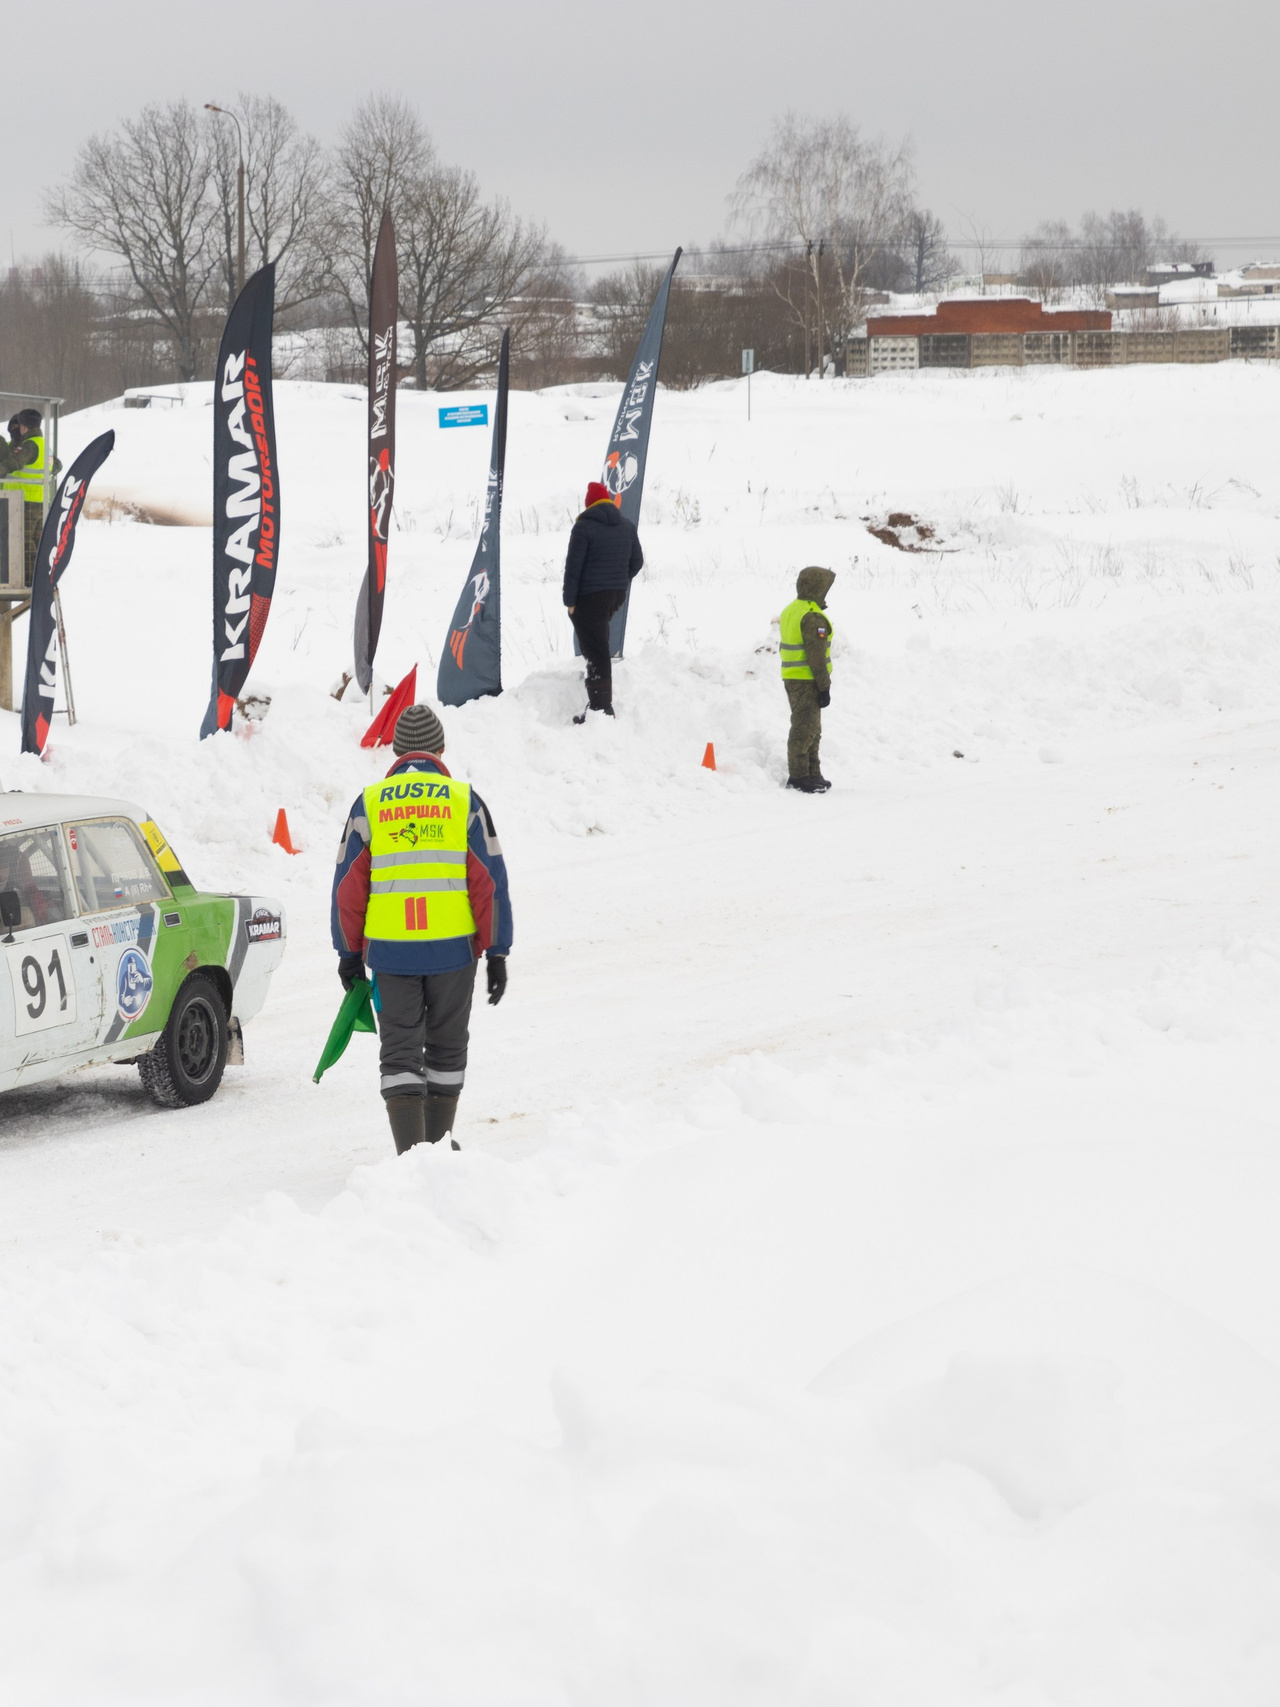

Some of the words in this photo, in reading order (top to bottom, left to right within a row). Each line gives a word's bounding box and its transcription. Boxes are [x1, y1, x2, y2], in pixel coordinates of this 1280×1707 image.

[244, 349, 274, 569] MOTORSPORT
[220, 349, 261, 662] KRAMAR
[379, 782, 451, 803] RUSTA
[379, 805, 452, 823] МАРШАЛ
[420, 824, 444, 838] MSK
[404, 896, 428, 931] 11
[248, 921, 280, 937] KRAMAR
[21, 948, 67, 1019] 91
